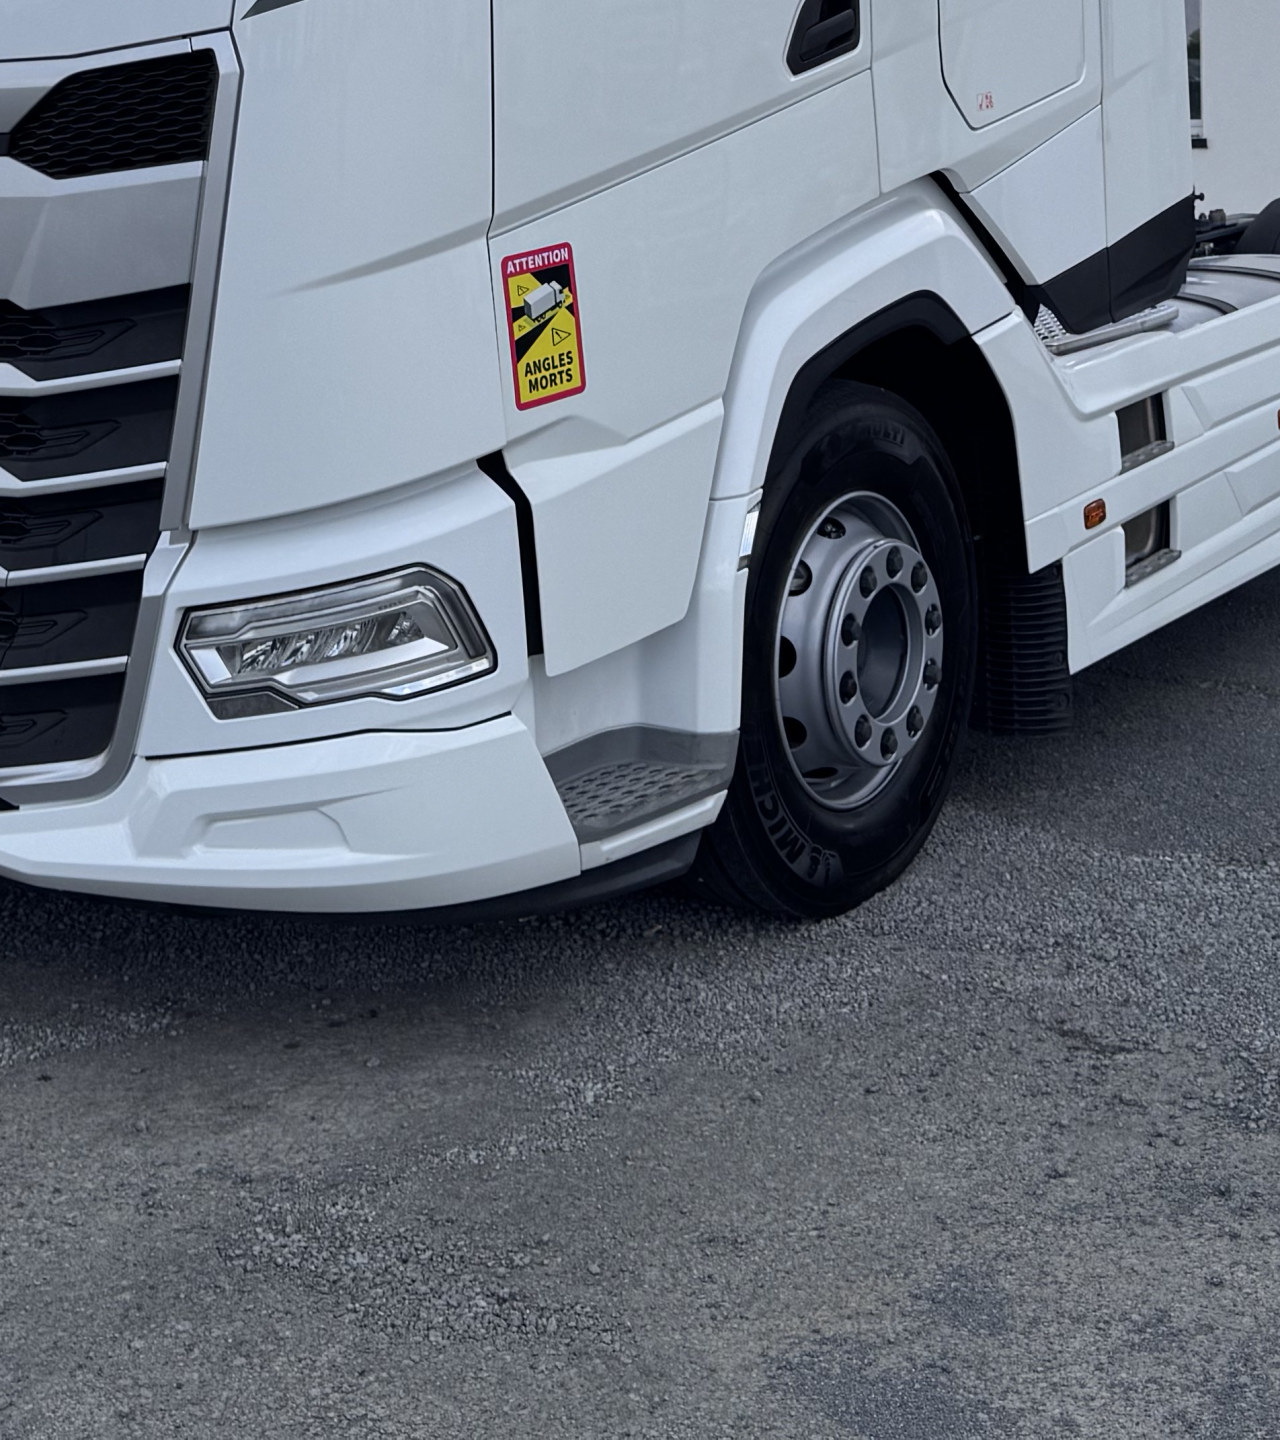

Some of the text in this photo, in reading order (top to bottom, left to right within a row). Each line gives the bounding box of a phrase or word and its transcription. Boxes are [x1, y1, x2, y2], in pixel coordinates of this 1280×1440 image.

[506, 247, 569, 275] ATTENTION
[524, 350, 574, 378] ANGLES
[528, 368, 573, 394] MORTS
